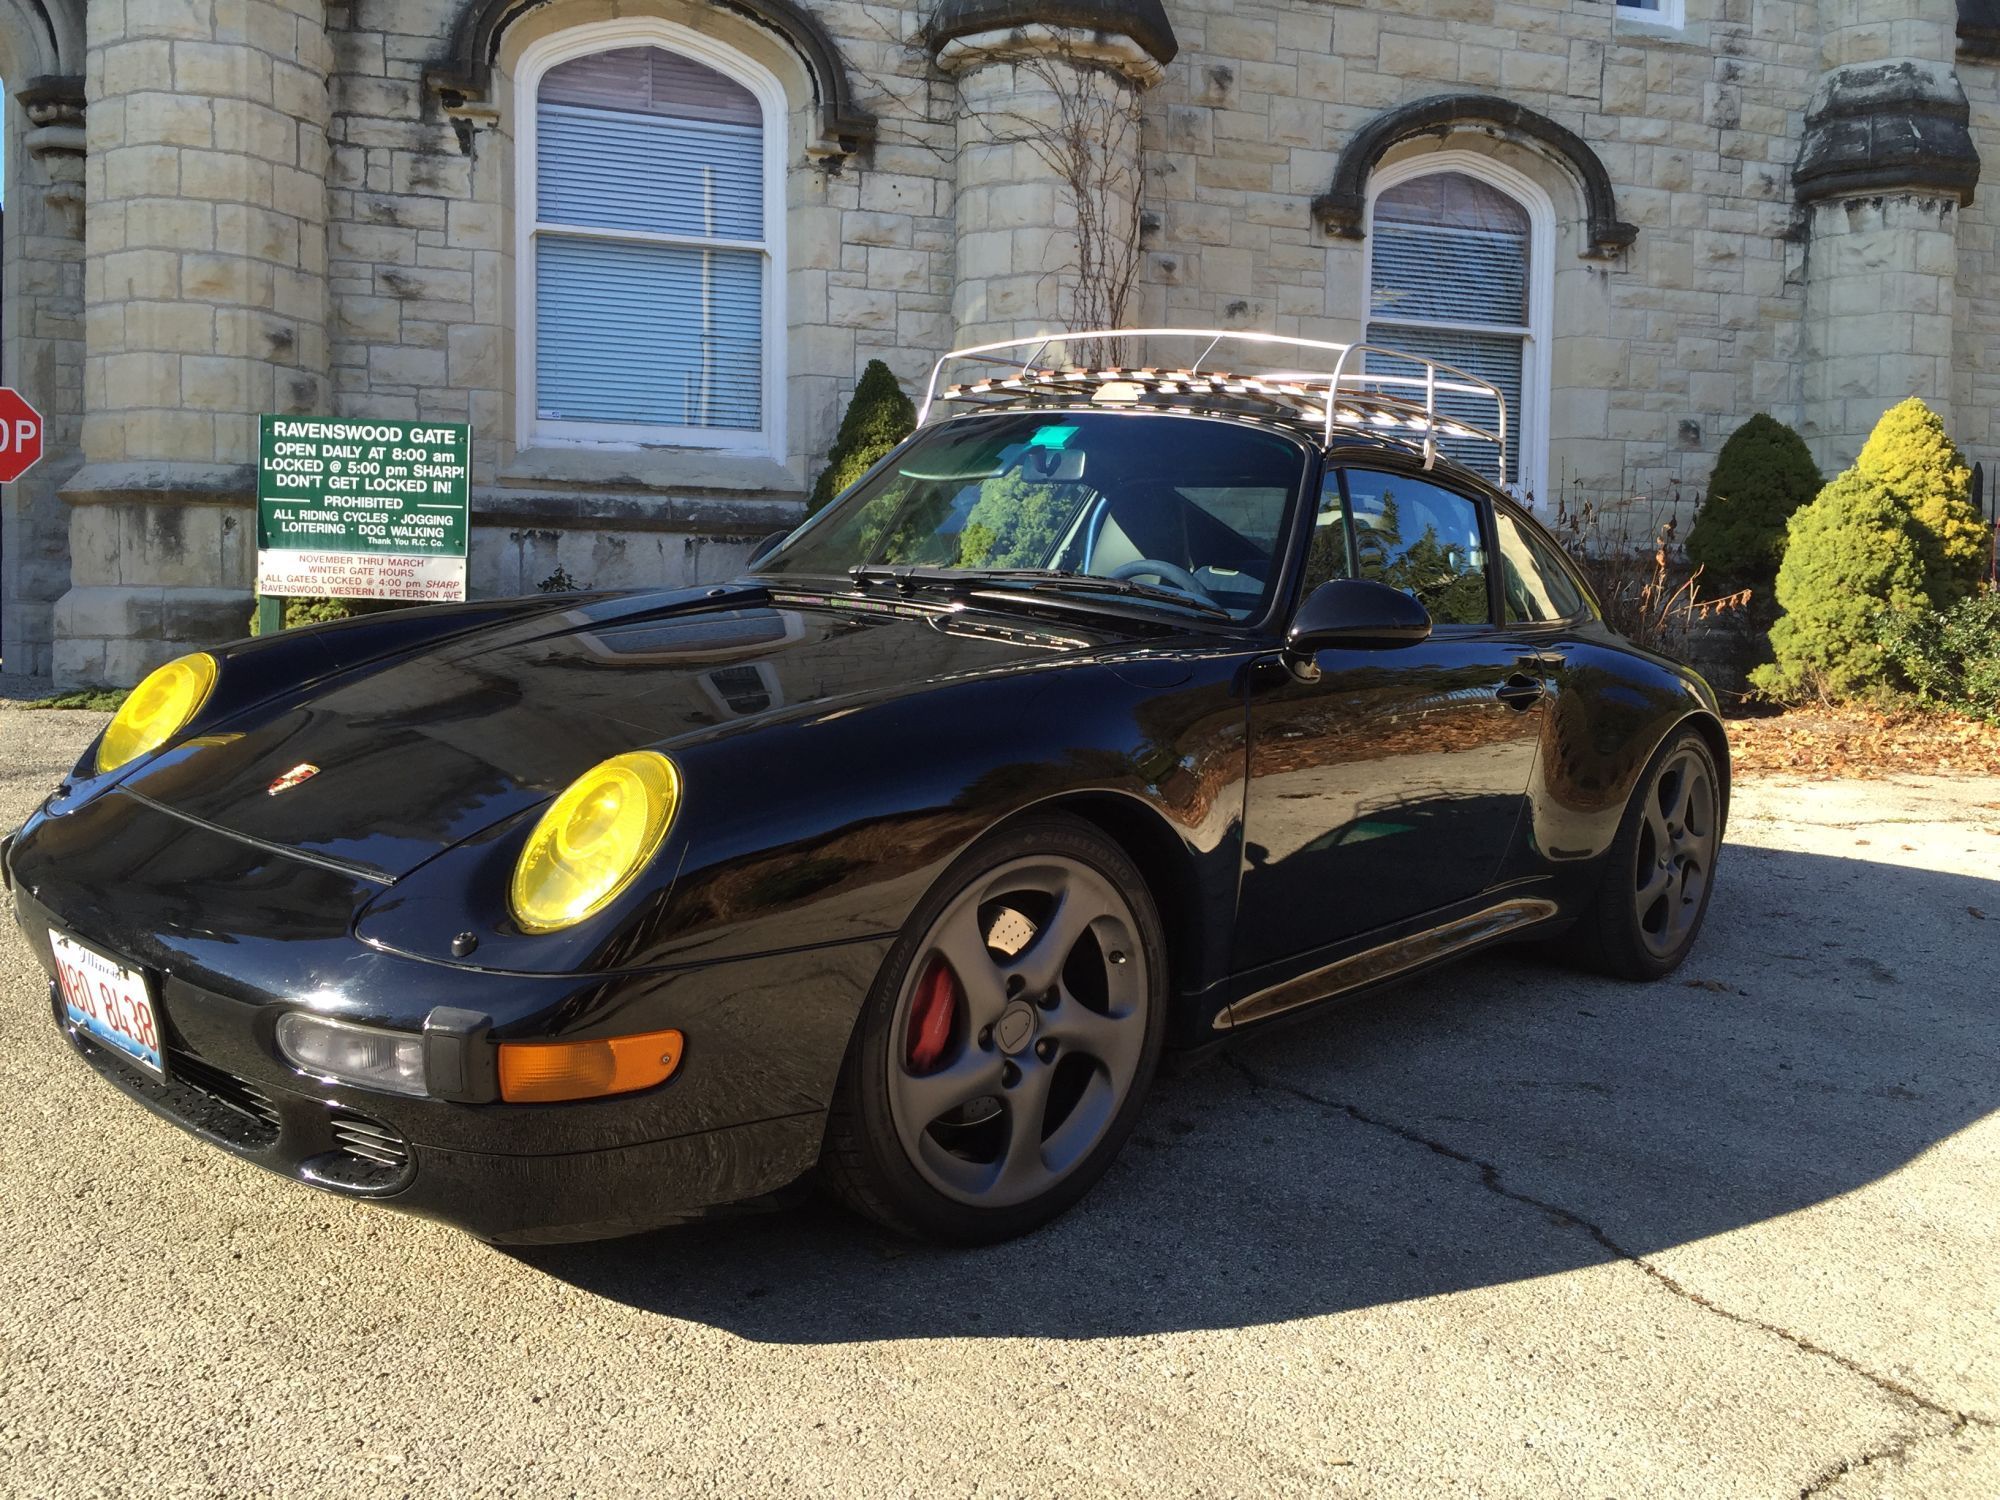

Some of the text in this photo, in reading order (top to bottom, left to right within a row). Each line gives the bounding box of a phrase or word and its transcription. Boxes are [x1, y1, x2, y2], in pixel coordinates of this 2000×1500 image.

[274, 422, 456, 444] RAVENSWOOD GATE
[274, 442, 455, 463] OPEN DAILY AT 8:00 am
[264, 458, 464, 478] LOCKED @ 5:00 pm SHARP!
[276, 474, 452, 494] DON'T GET LOCKED IN!
[324, 495, 404, 510] PROHIBITED
[273, 509, 454, 526] ALL RIDING CYCLES JOGGING
[281, 521, 445, 538] LOITERING DOG WALKING
[367, 537, 392, 545] Thank
[394, 538, 410, 546] You
[411, 539, 428, 547] R.C.
[299, 555, 425, 568] NOVEMBER THRU MARCH
[308, 566, 415, 578] WINTER GATE HOURS
[265, 574, 283, 583] ALL
[286, 575, 318, 584] GATES
[321, 576, 362, 586] LOCKED
[378, 578, 402, 588] 4:00
[405, 580, 421, 589] pm
[425, 580, 460, 589] SHARP
[261, 584, 327, 595] RAVENSWOOD,
[330, 586, 375, 596] WESTERN
[378, 587, 385, 597] &
[389, 589, 439, 599] PETERSON
[55, 957, 157, 1051] N80 8438
